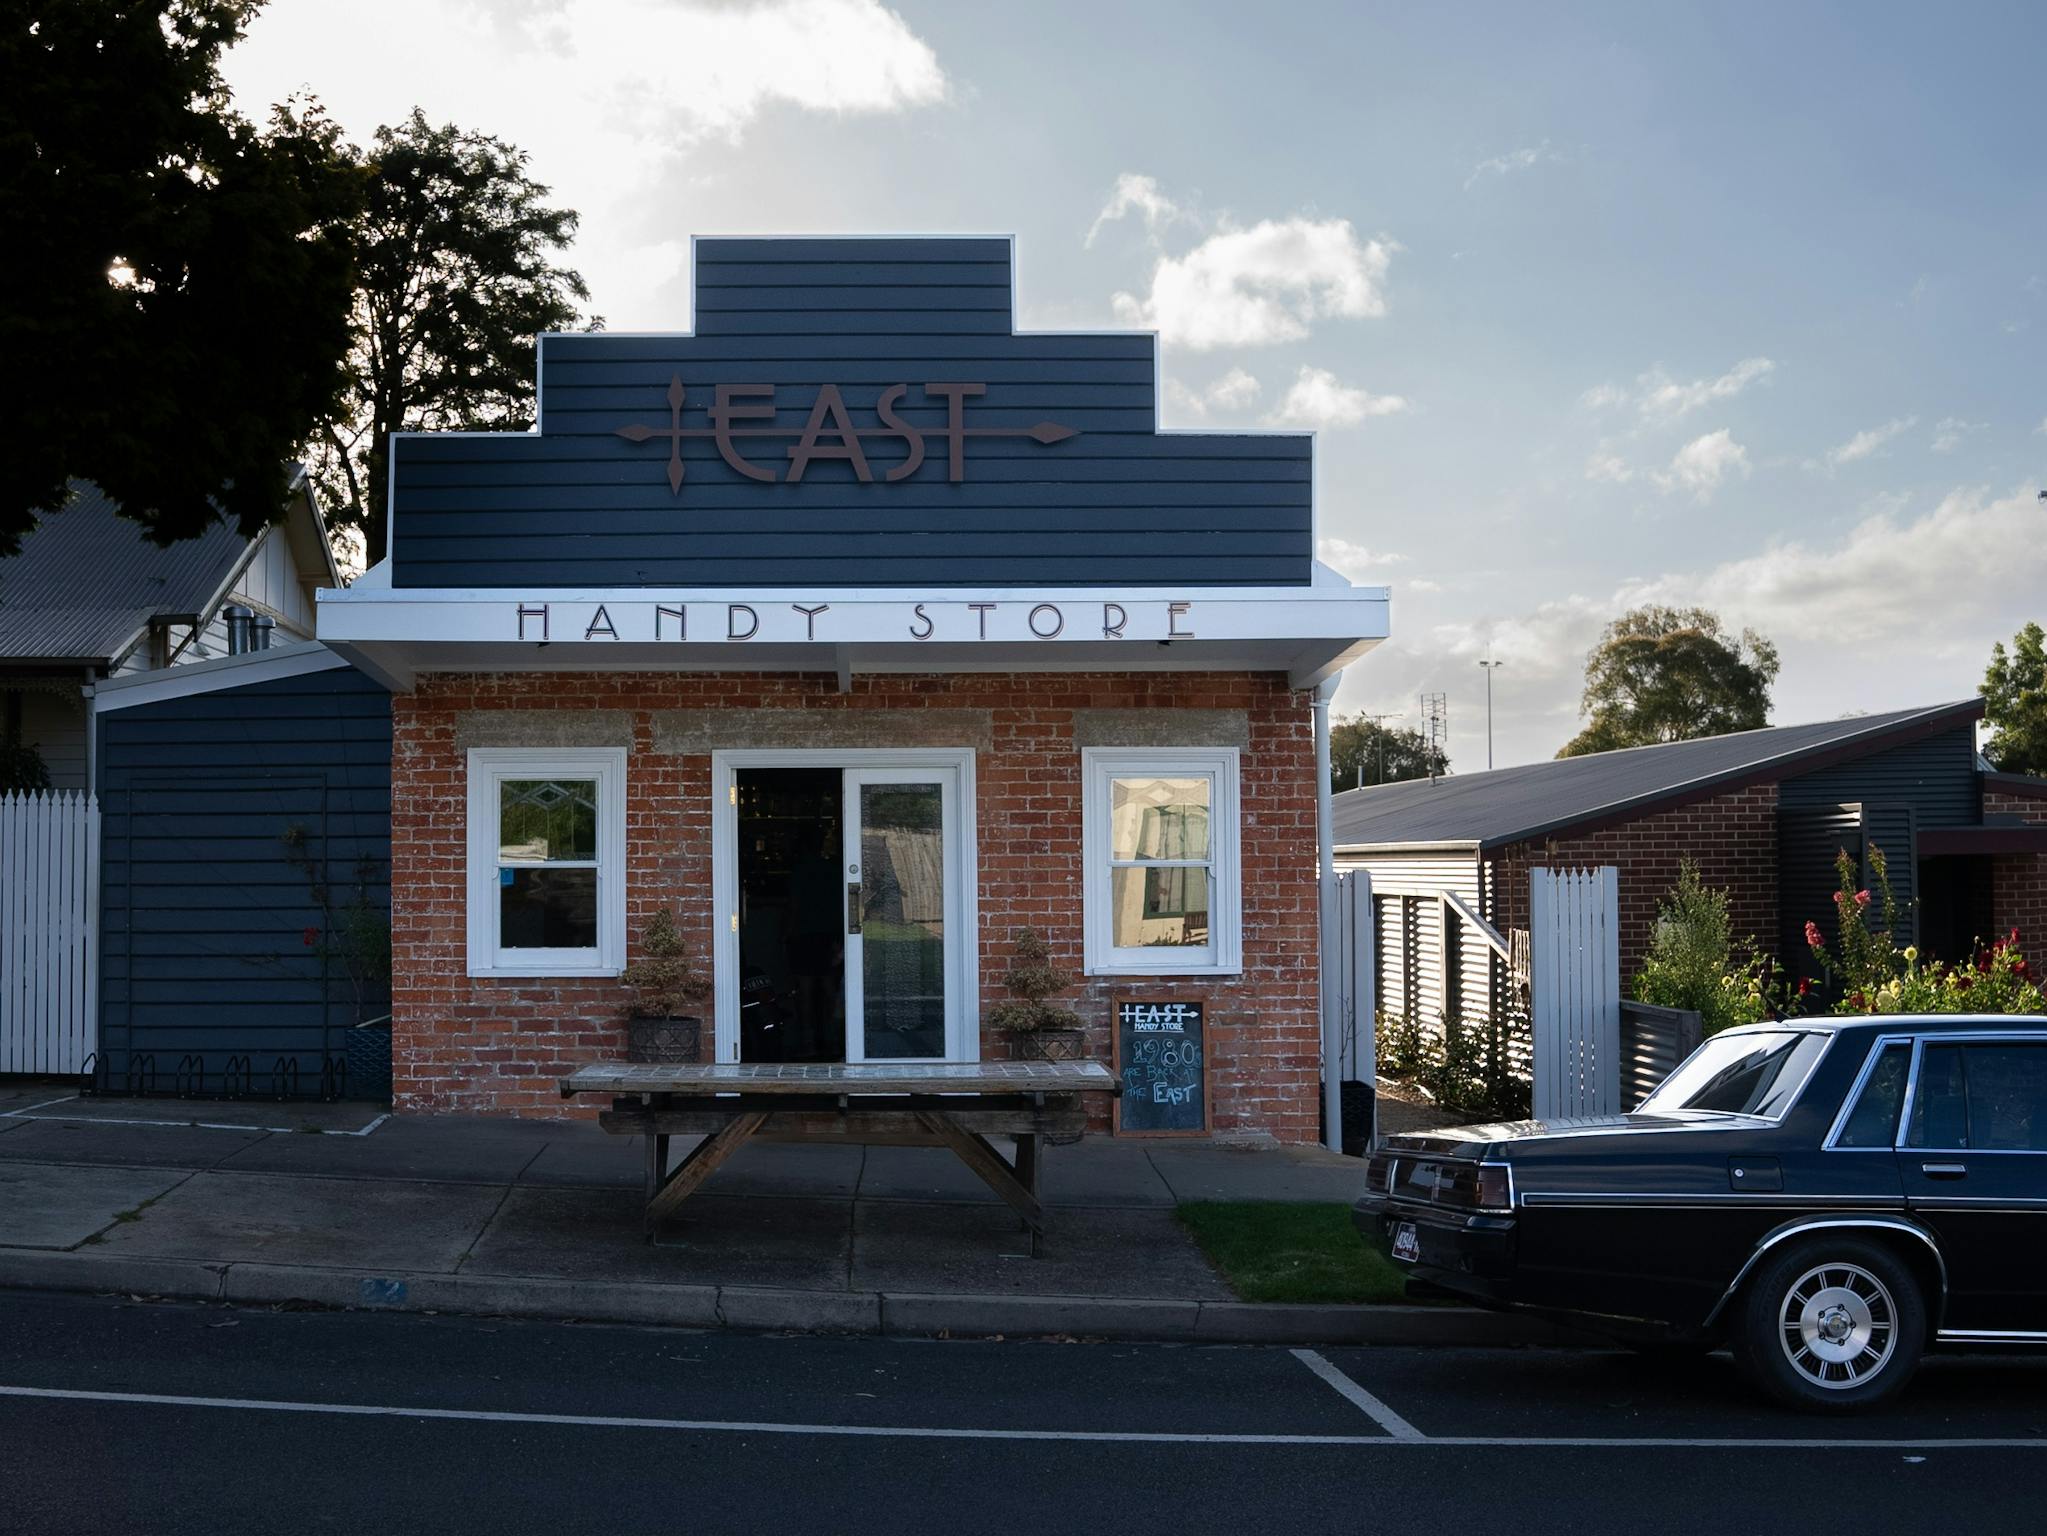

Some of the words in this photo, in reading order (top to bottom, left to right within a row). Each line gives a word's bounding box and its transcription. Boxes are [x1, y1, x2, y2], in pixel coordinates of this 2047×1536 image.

[707, 382, 987, 484] EAST
[516, 602, 829, 642] HANDY
[908, 601, 1195, 641] STORE
[1134, 1004, 1186, 1023] EAST
[1134, 1022, 1158, 1031] HANDY
[1161, 1022, 1184, 1031] STORE
[1124, 1067, 1142, 1078] ARE
[1127, 1084, 1147, 1100] THE
[1152, 1081, 1197, 1106] EAST
